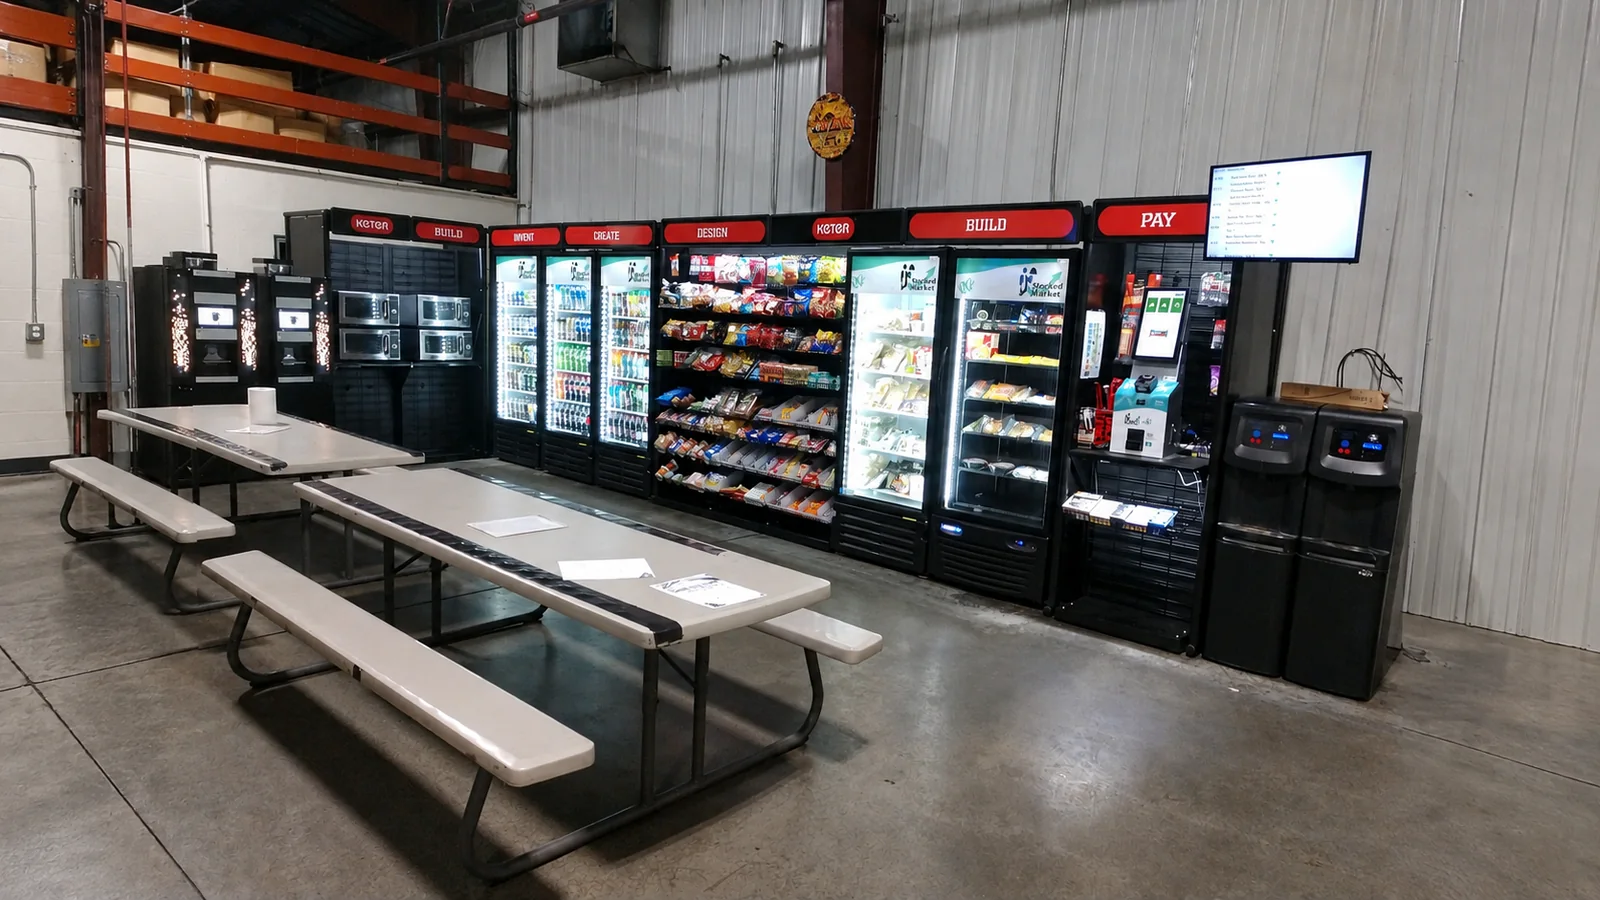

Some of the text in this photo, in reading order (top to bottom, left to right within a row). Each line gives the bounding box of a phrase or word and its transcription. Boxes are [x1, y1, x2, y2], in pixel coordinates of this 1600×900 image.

[965, 218, 1007, 232] BUILD
[1140, 212, 1176, 228] PAY
[434, 227, 463, 239] BUILD
[513, 232, 535, 242] INVENT
[593, 231, 620, 241] CREATE
[697, 227, 728, 238] DESIGN
[1030, 289, 1061, 298] Market
